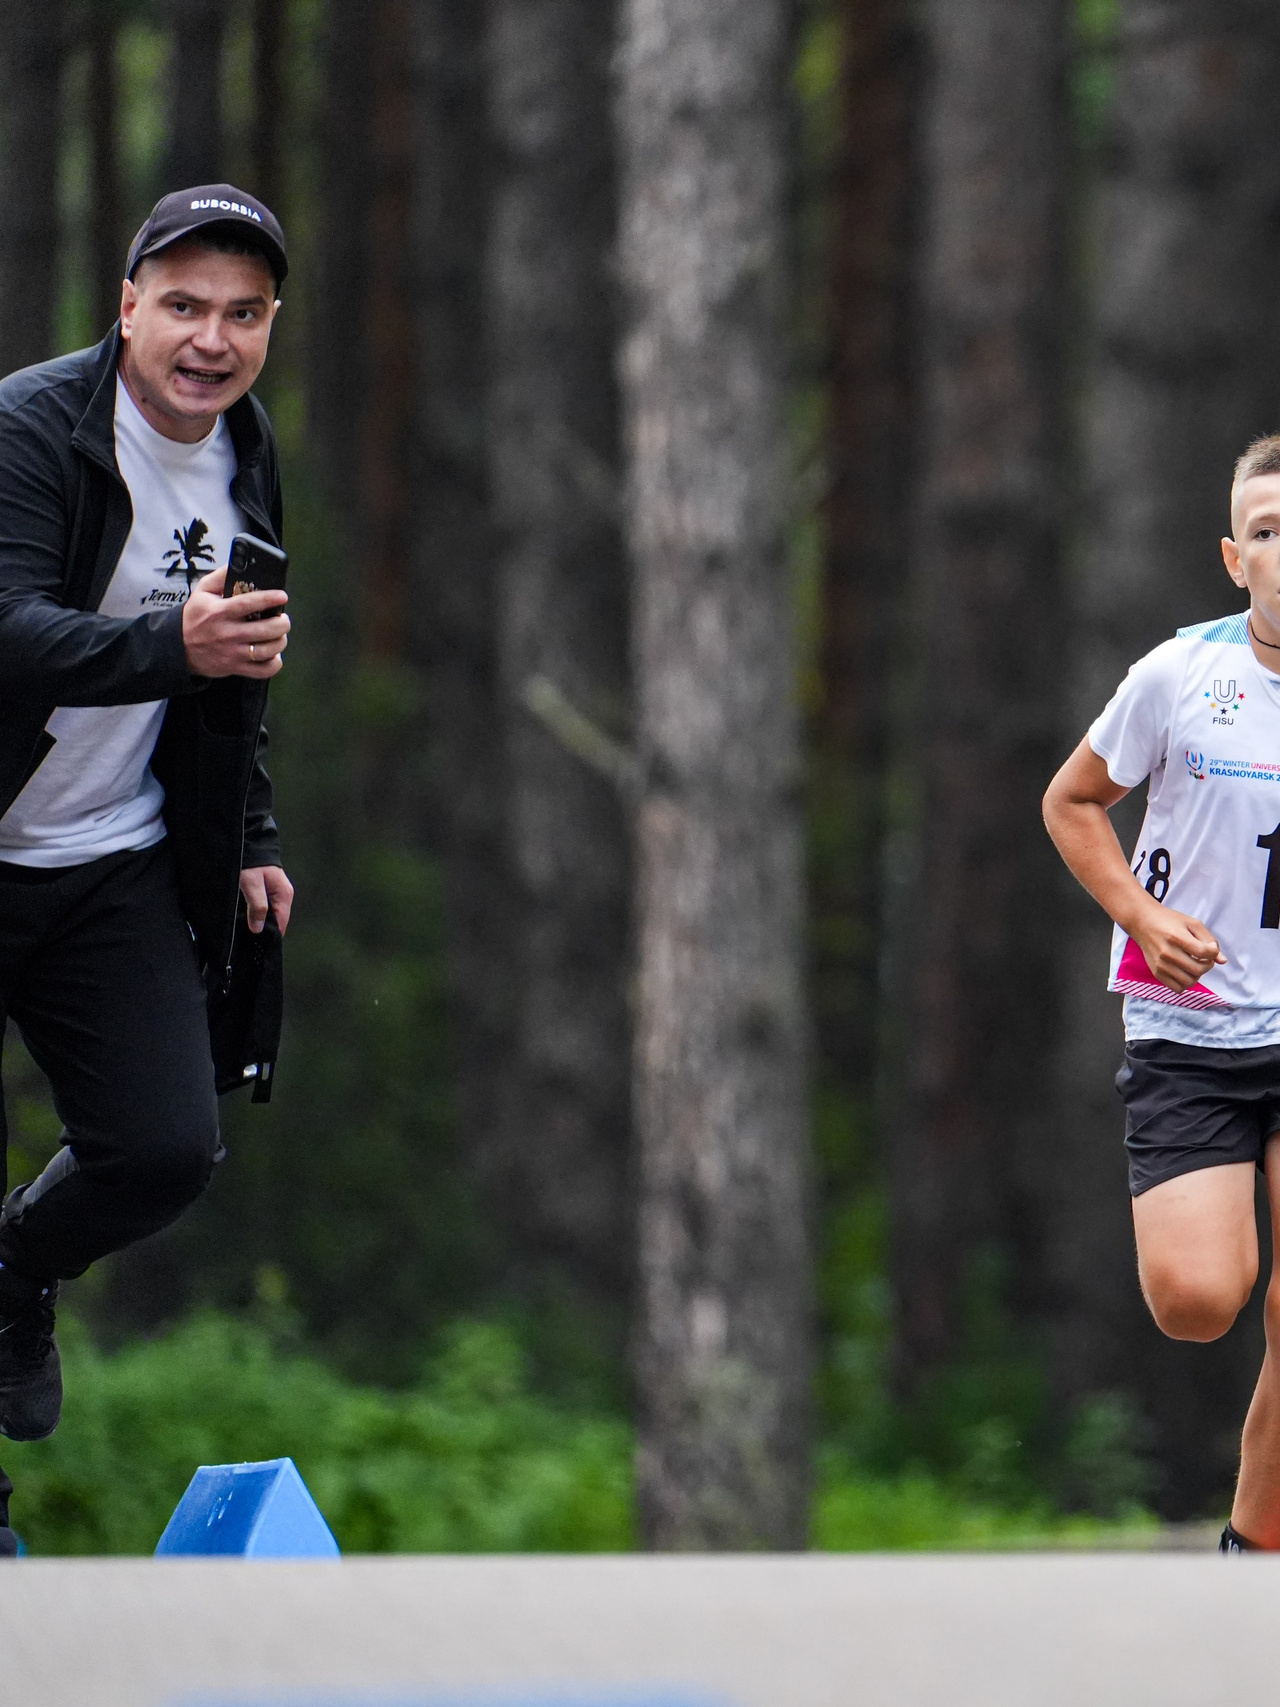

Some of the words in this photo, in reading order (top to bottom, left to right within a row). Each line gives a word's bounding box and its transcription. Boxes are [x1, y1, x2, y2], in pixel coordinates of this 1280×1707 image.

[190, 199, 262, 222] SUBORBIA
[1212, 717, 1234, 725] FISU
[1223, 760, 1250, 768] WINTER
[1209, 767, 1274, 781] KRASNOYARSK
